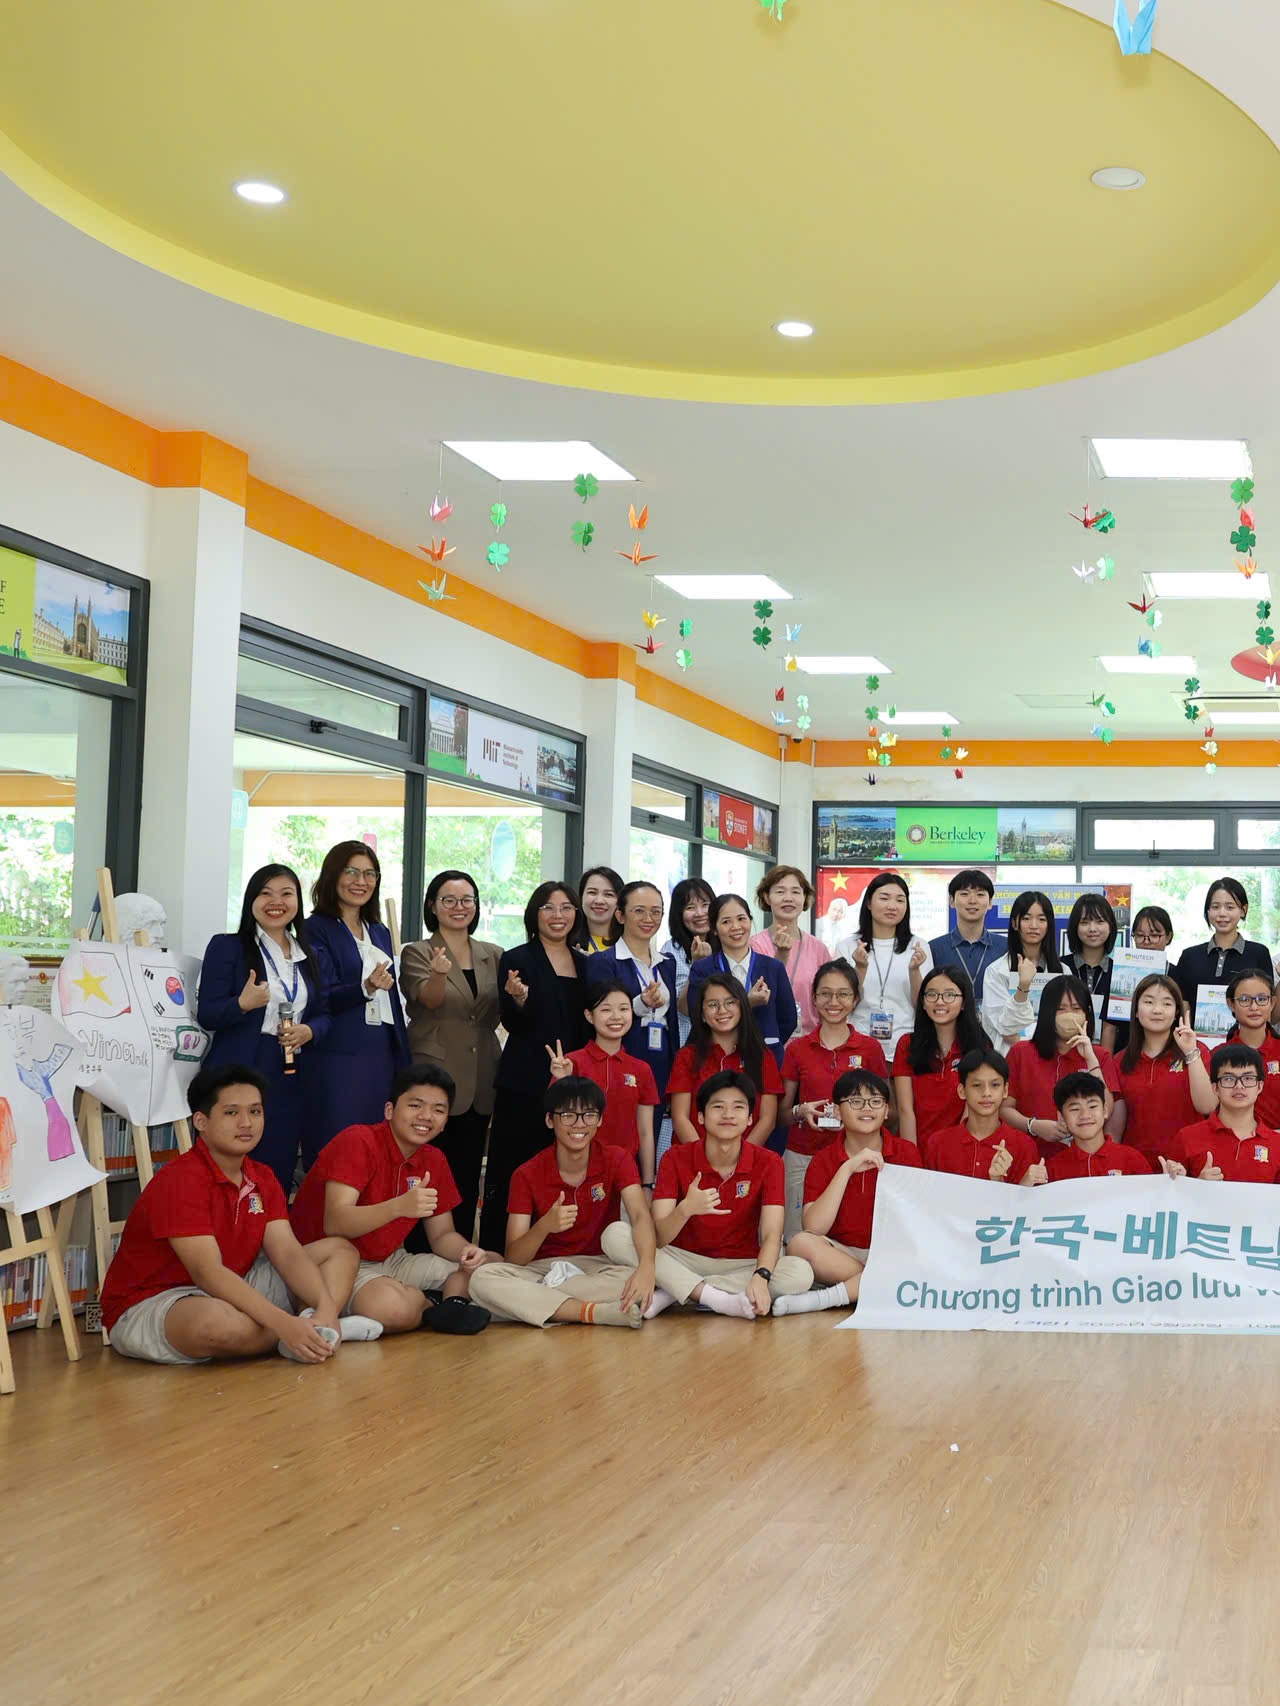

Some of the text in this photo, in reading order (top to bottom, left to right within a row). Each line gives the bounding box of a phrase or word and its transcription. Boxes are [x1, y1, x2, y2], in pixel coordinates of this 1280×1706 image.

[930, 826, 986, 845] Berkeley
[1131, 953, 1154, 961] HUTECH
[896, 1280, 1021, 1314] Chương
[1030, 1279, 1102, 1307] trình
[1112, 1275, 1182, 1304] Giao
[1192, 1272, 1241, 1299] lưu
